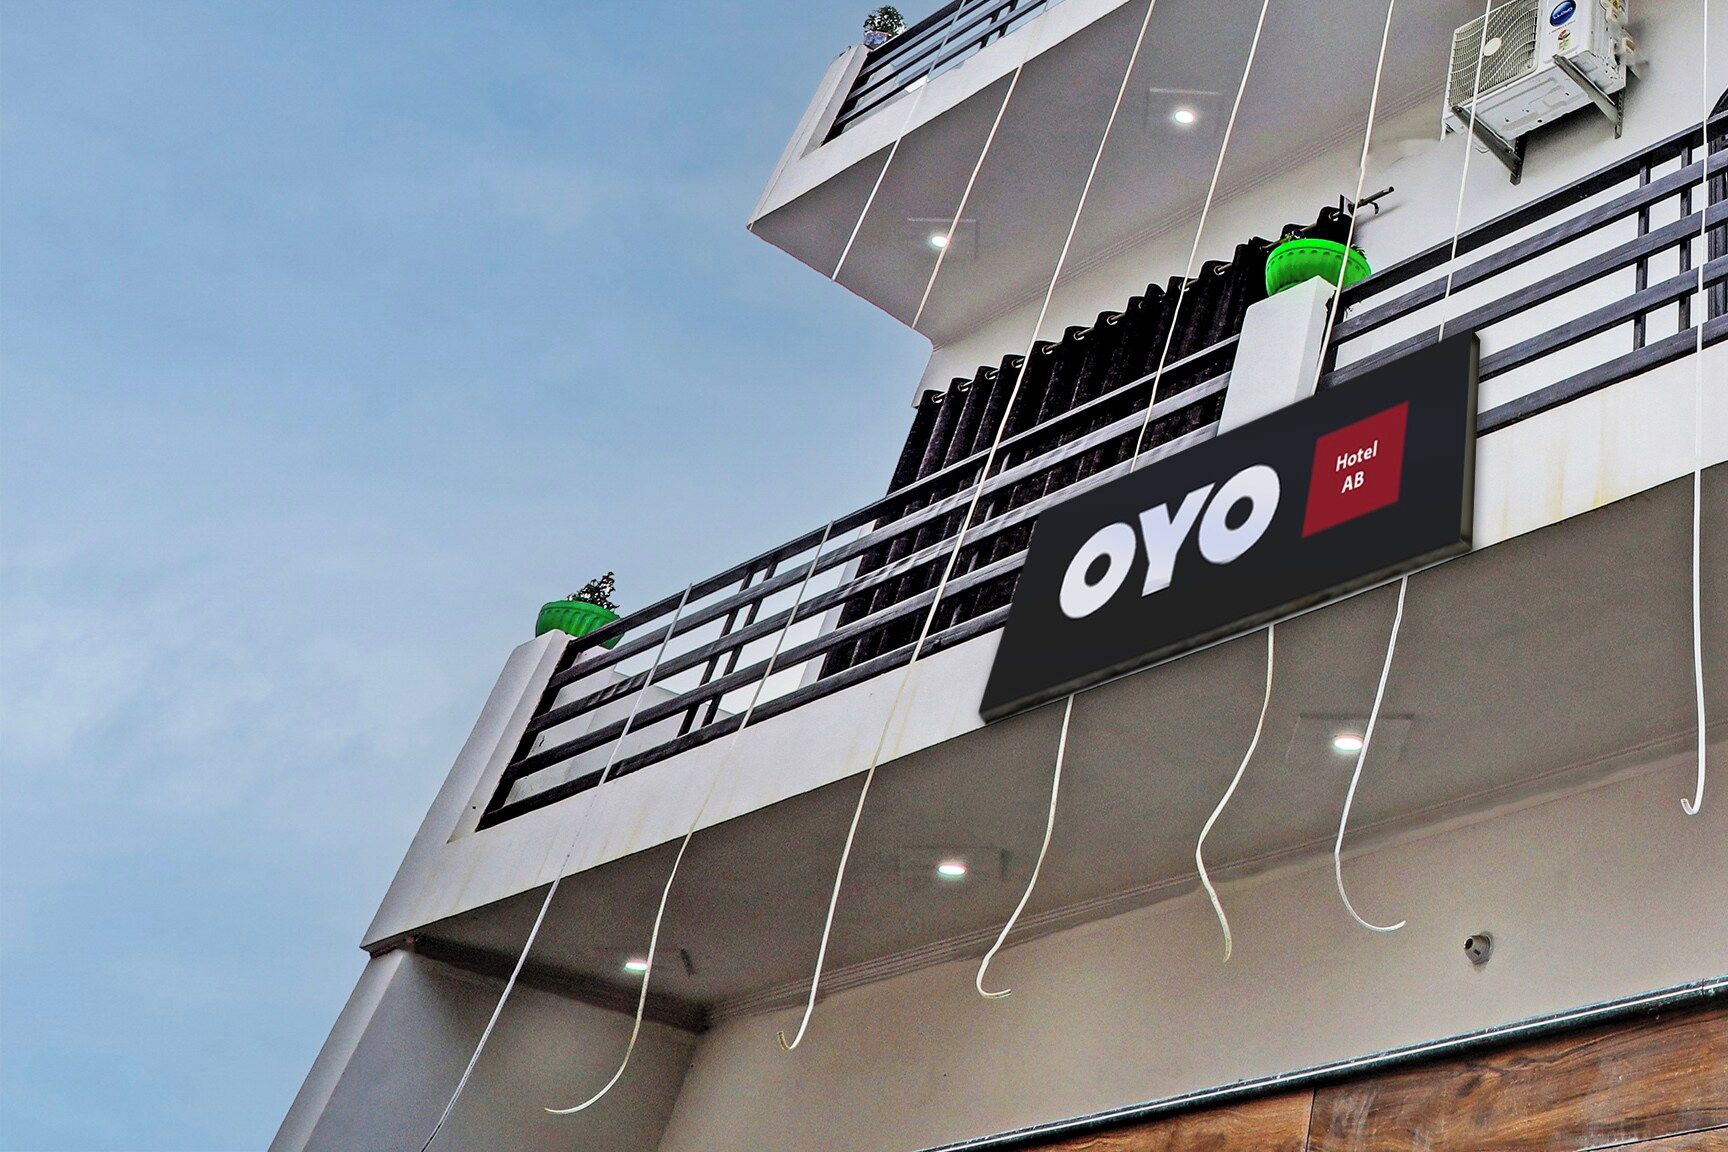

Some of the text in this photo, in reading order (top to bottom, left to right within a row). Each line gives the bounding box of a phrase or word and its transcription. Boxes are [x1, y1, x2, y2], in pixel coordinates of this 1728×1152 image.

[1335, 439, 1379, 472] Hotel
[1340, 470, 1365, 494] AB
[1059, 464, 1281, 619] OYO
